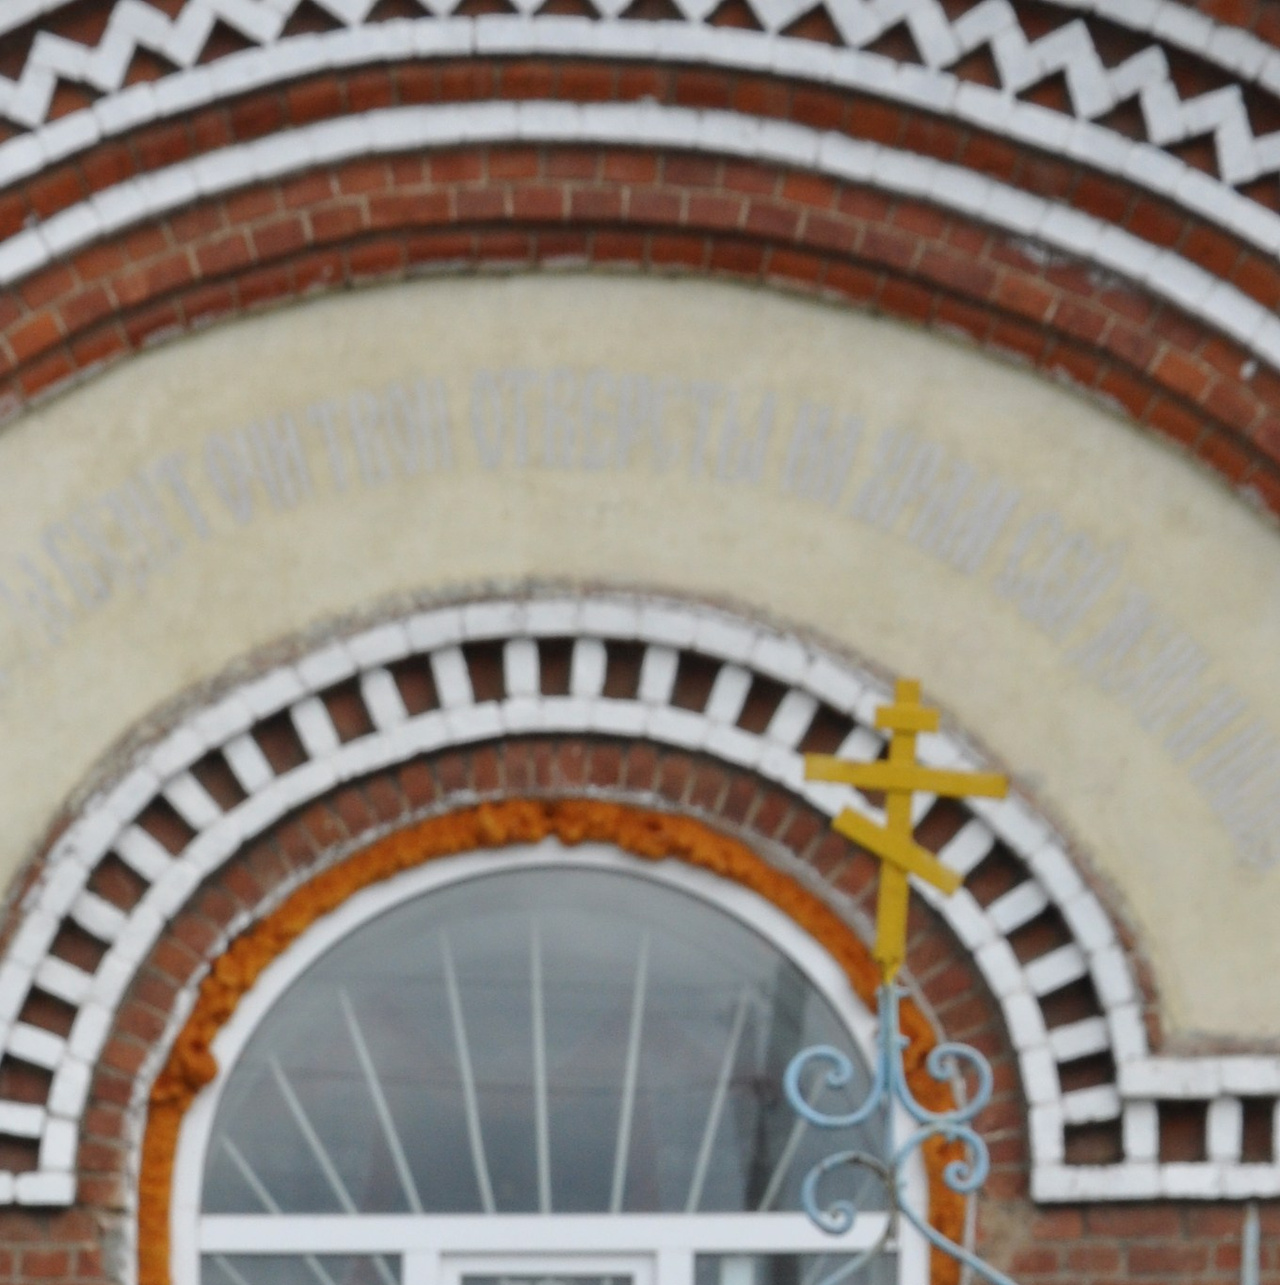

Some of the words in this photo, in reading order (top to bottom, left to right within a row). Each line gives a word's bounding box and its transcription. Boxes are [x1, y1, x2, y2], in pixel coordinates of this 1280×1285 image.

[466, 365, 778, 487] ОТВЕРСТЫ
[781, 402, 864, 506] НА
[853, 426, 1020, 575] ХРАМ
[991, 504, 1129, 643] СЕЙ
